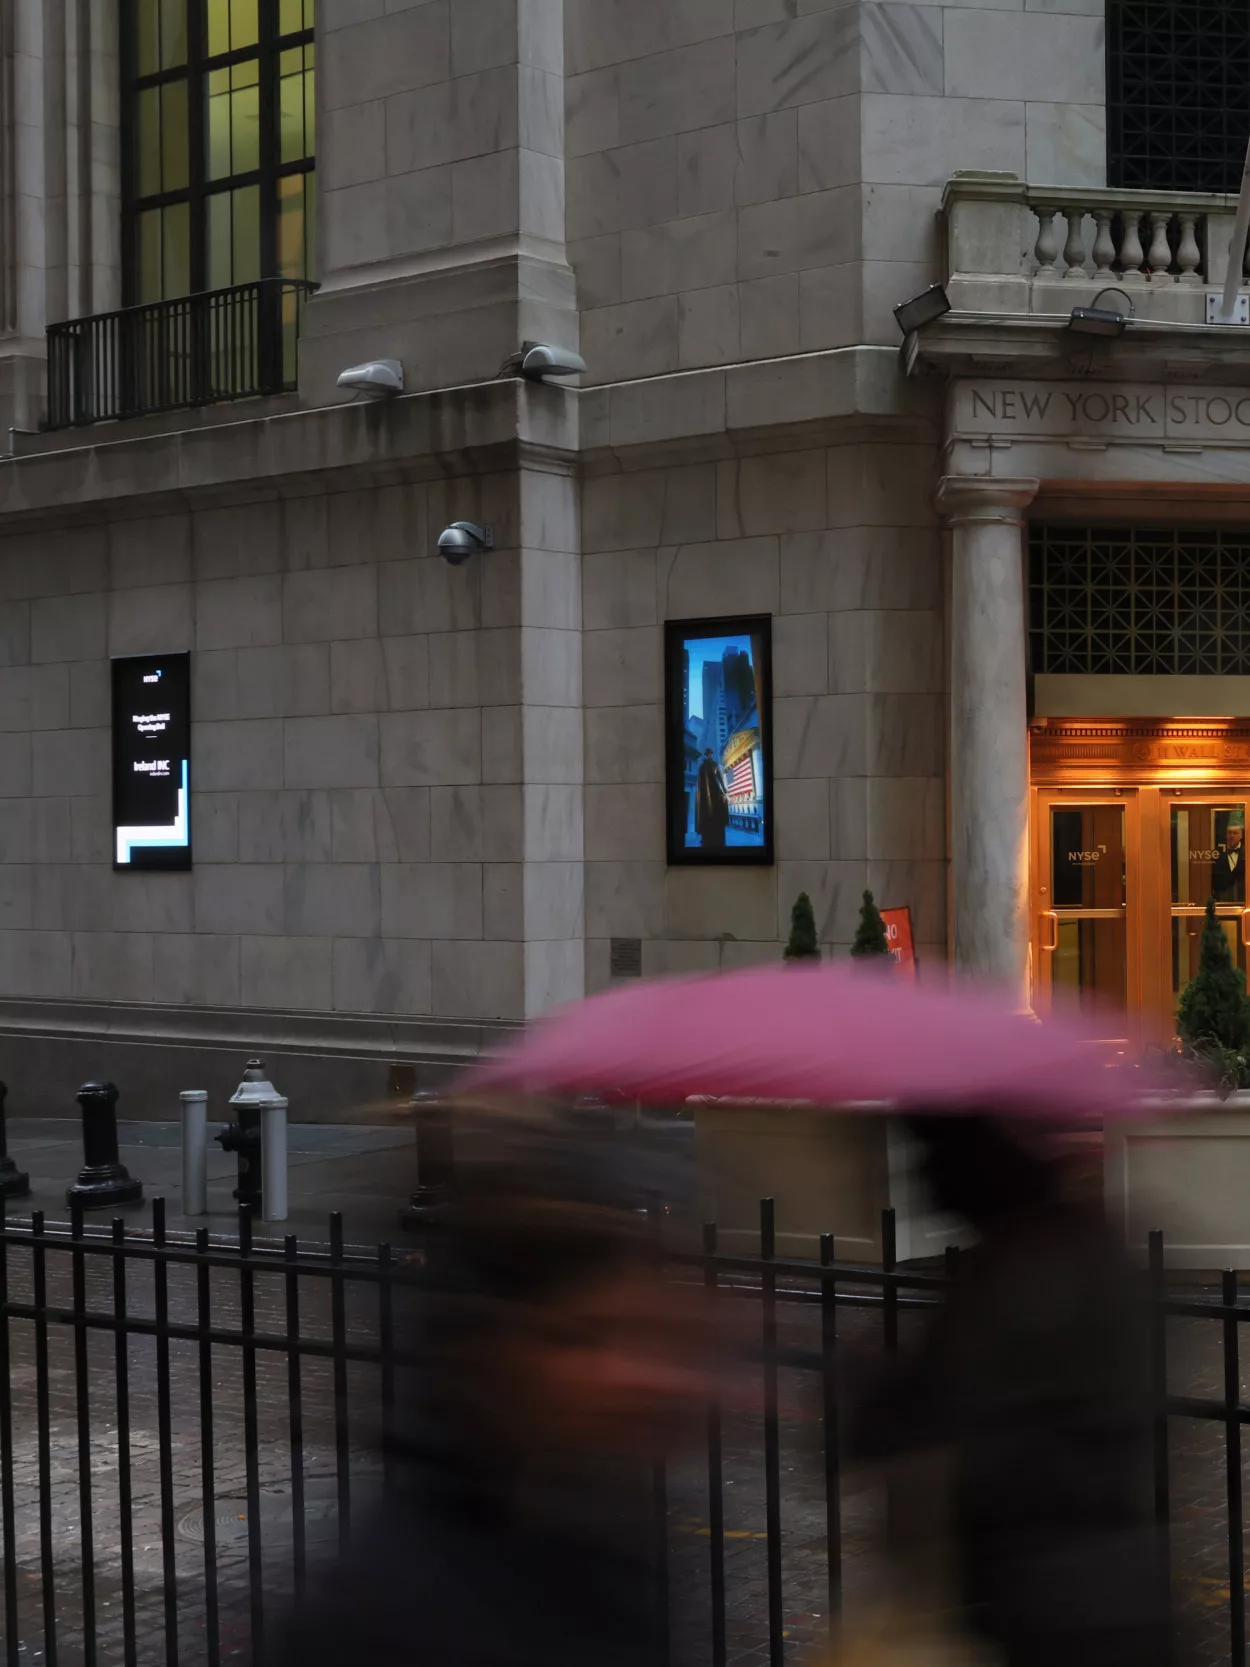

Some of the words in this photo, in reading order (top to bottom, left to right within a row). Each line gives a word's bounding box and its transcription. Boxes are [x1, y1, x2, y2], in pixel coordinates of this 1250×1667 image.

[970, 389, 1051, 420] NEW
[1063, 393, 1156, 425] YORK
[1173, 743, 1219, 758] WALL
[1224, 744, 1241, 758] ST
